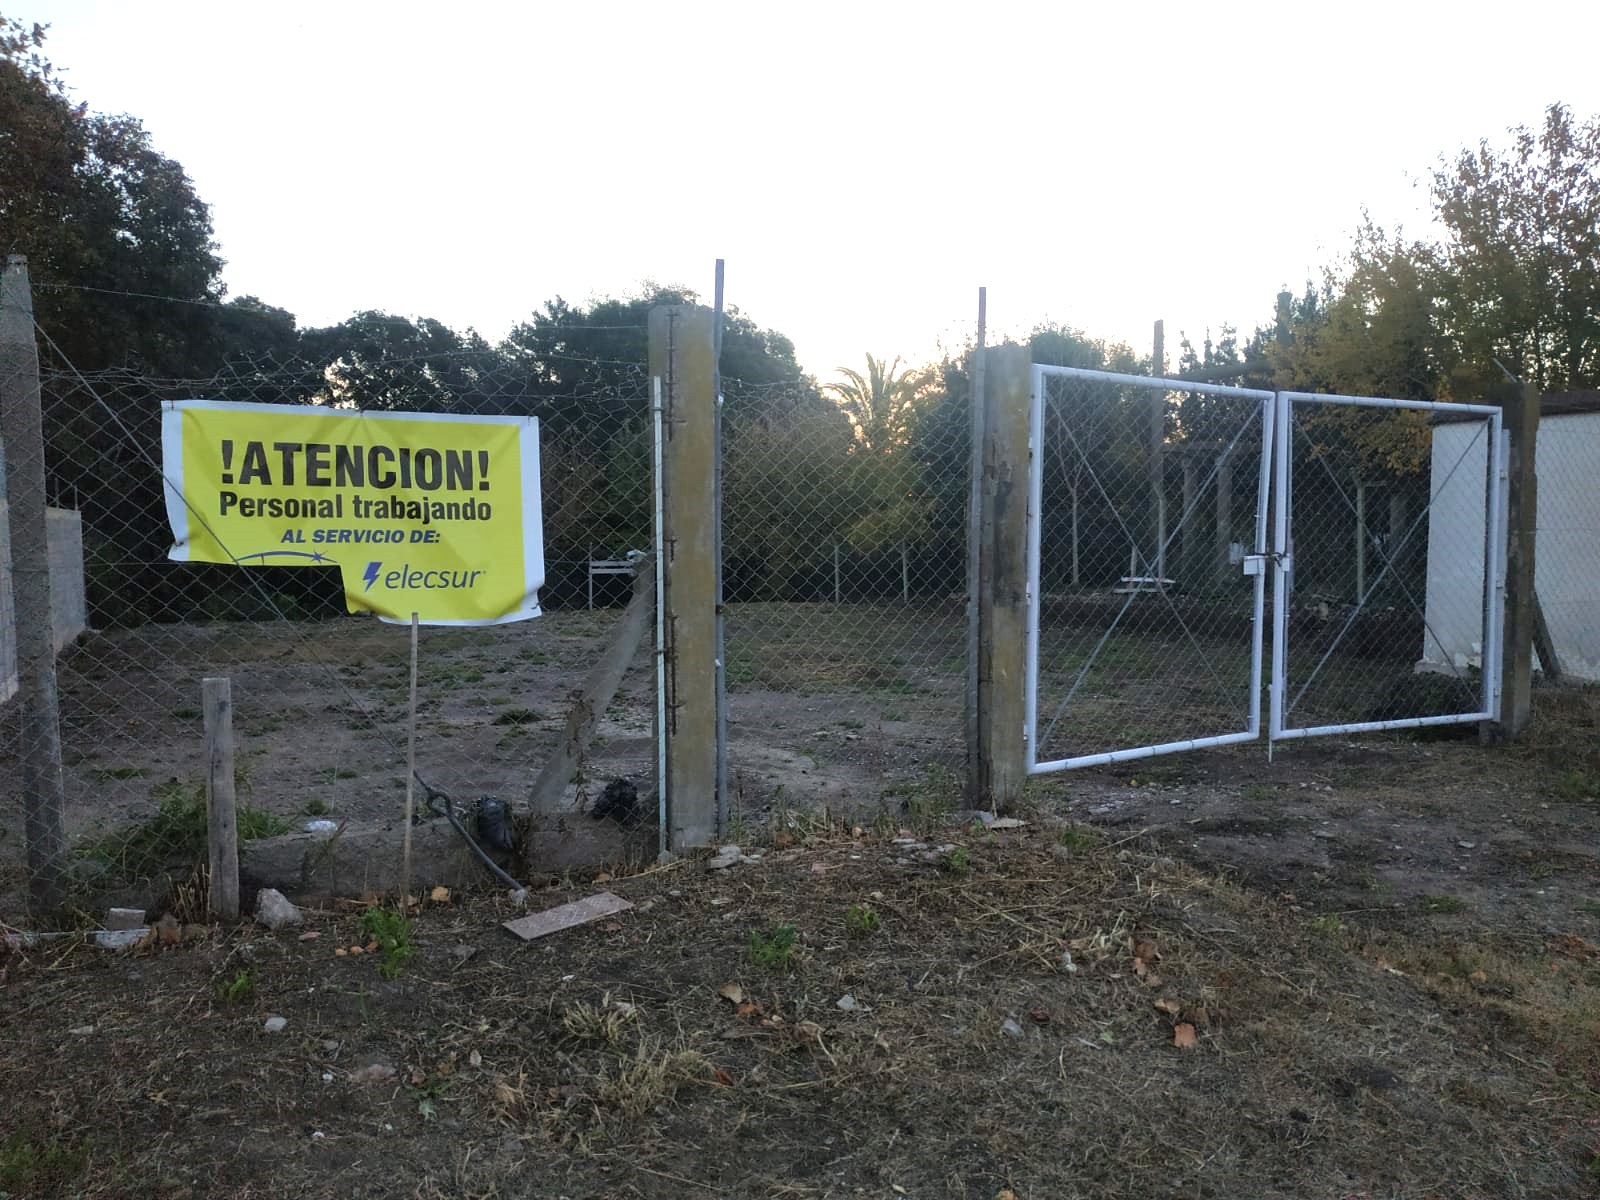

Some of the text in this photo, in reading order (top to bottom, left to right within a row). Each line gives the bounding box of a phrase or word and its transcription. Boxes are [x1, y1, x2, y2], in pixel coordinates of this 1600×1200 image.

[220, 439, 490, 491] !ATENCION!
[219, 491, 492, 525] Personal trabajando
[281, 529, 441, 544] AL SERVICIO DE:
[385, 564, 481, 590] elecsur
